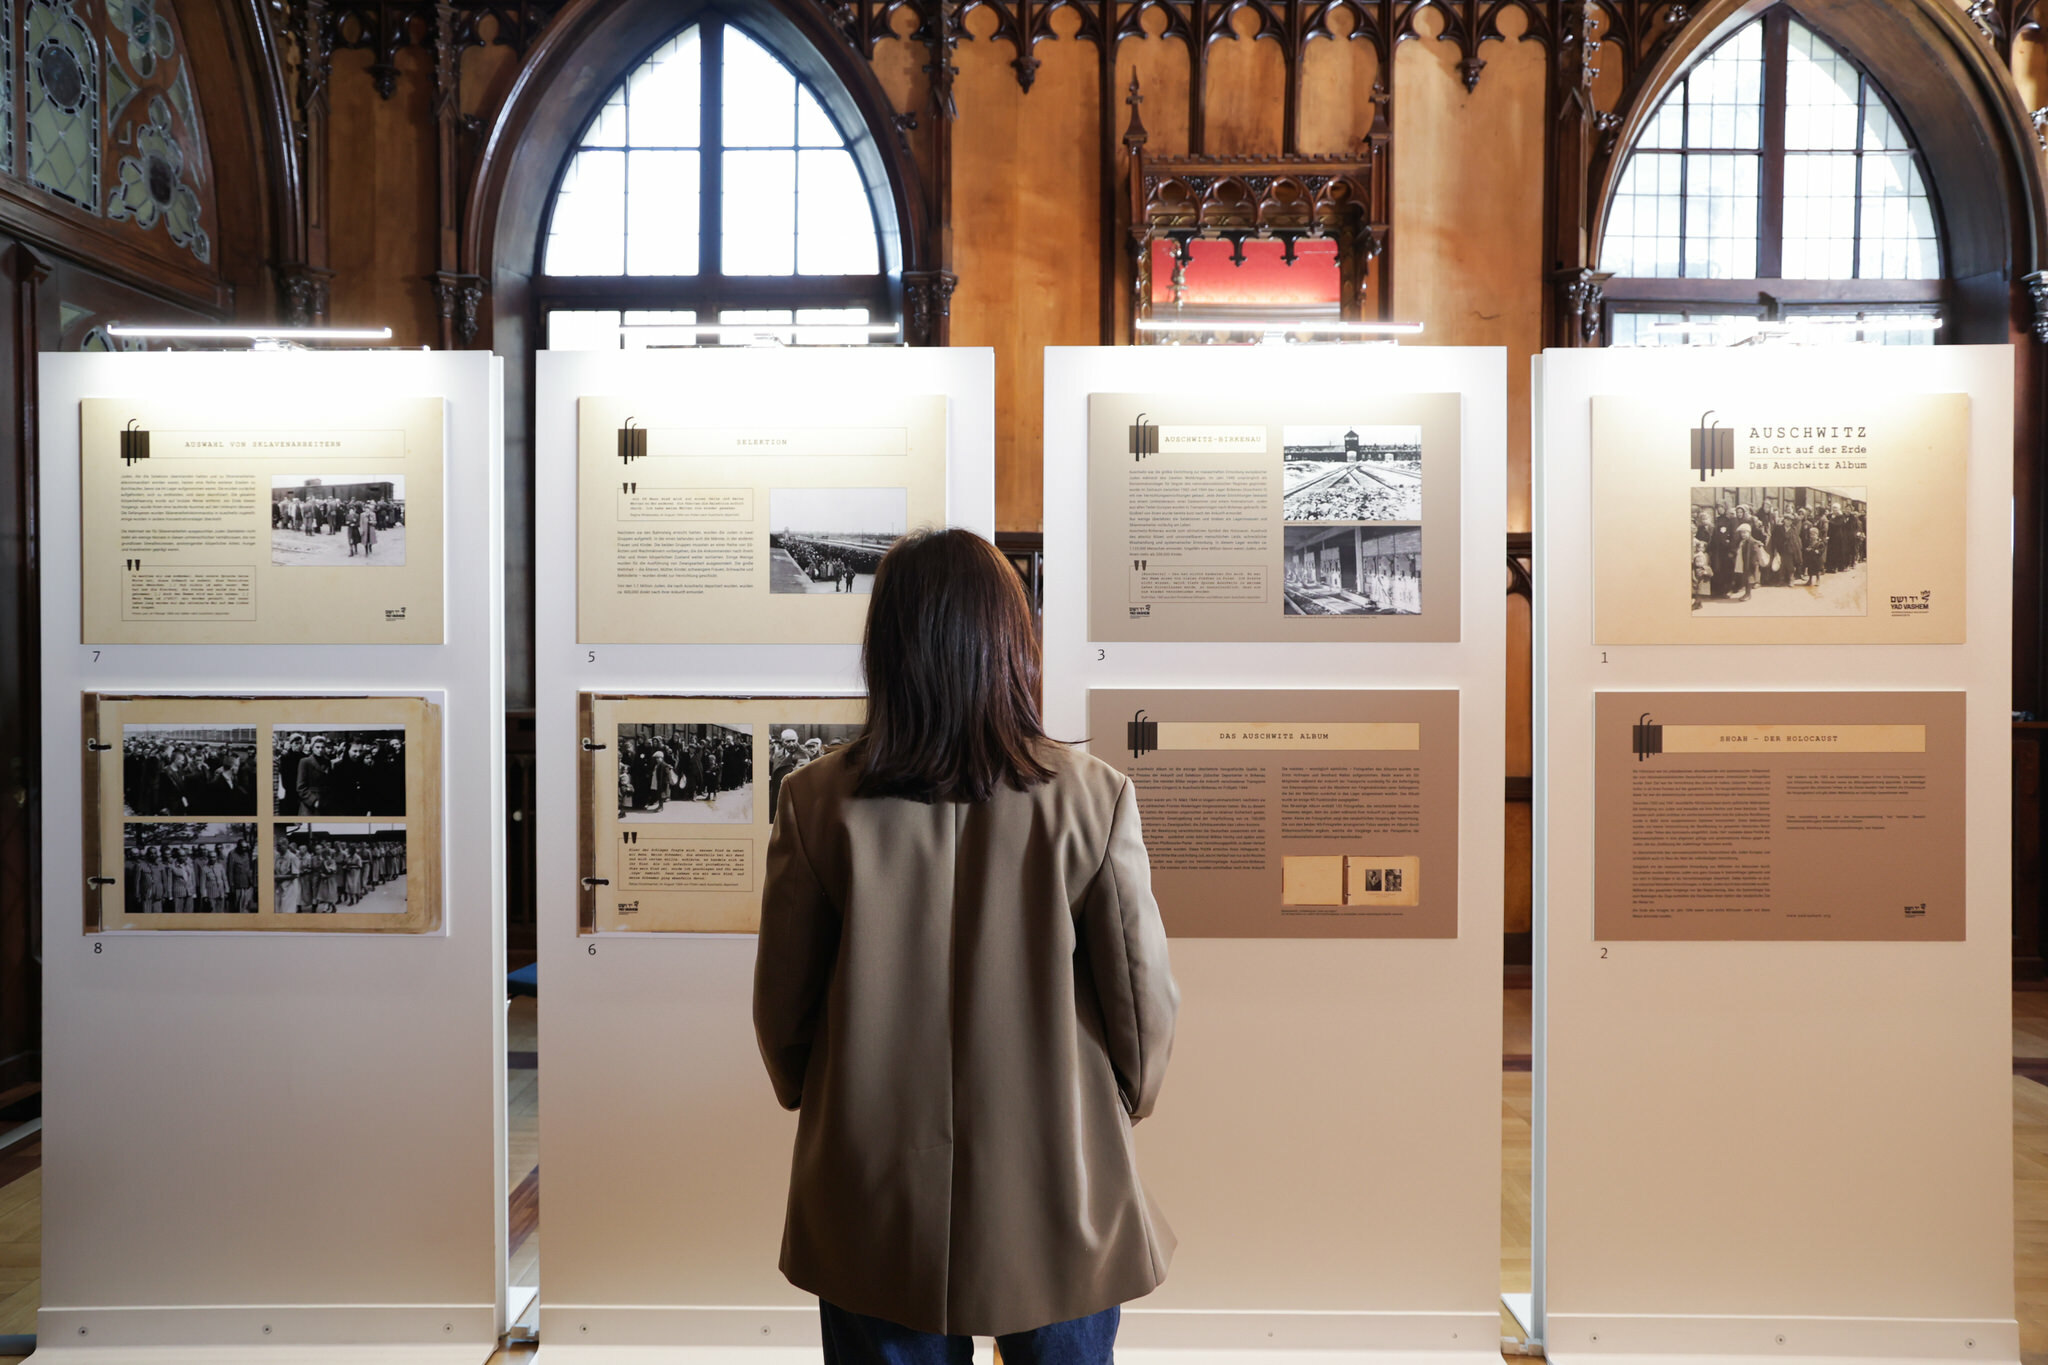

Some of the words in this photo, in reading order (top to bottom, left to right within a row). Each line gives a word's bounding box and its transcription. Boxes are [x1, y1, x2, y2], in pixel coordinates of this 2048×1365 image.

[1749, 426, 1867, 439] AUSCHWITZ
[1749, 445, 1769, 455] Ein
[1772, 445, 1792, 454] Ort
[1795, 445, 1814, 454] auf
[1818, 445, 1838, 454] der
[1841, 445, 1867, 454] Erde
[1749, 461, 1768, 470] Das
[1773, 461, 1830, 470] Auschwitz
[1835, 460, 1868, 470] Album
[92, 650, 101, 663] 7
[587, 650, 596, 663] 5
[1097, 648, 1106, 661] 3
[1601, 651, 1608, 664] 1
[1219, 732, 1237, 740] DAS
[1242, 732, 1294, 740] AUSCHWITZ
[93, 941, 103, 955] 8
[587, 943, 597, 956] 6
[1600, 947, 1609, 960] 2
